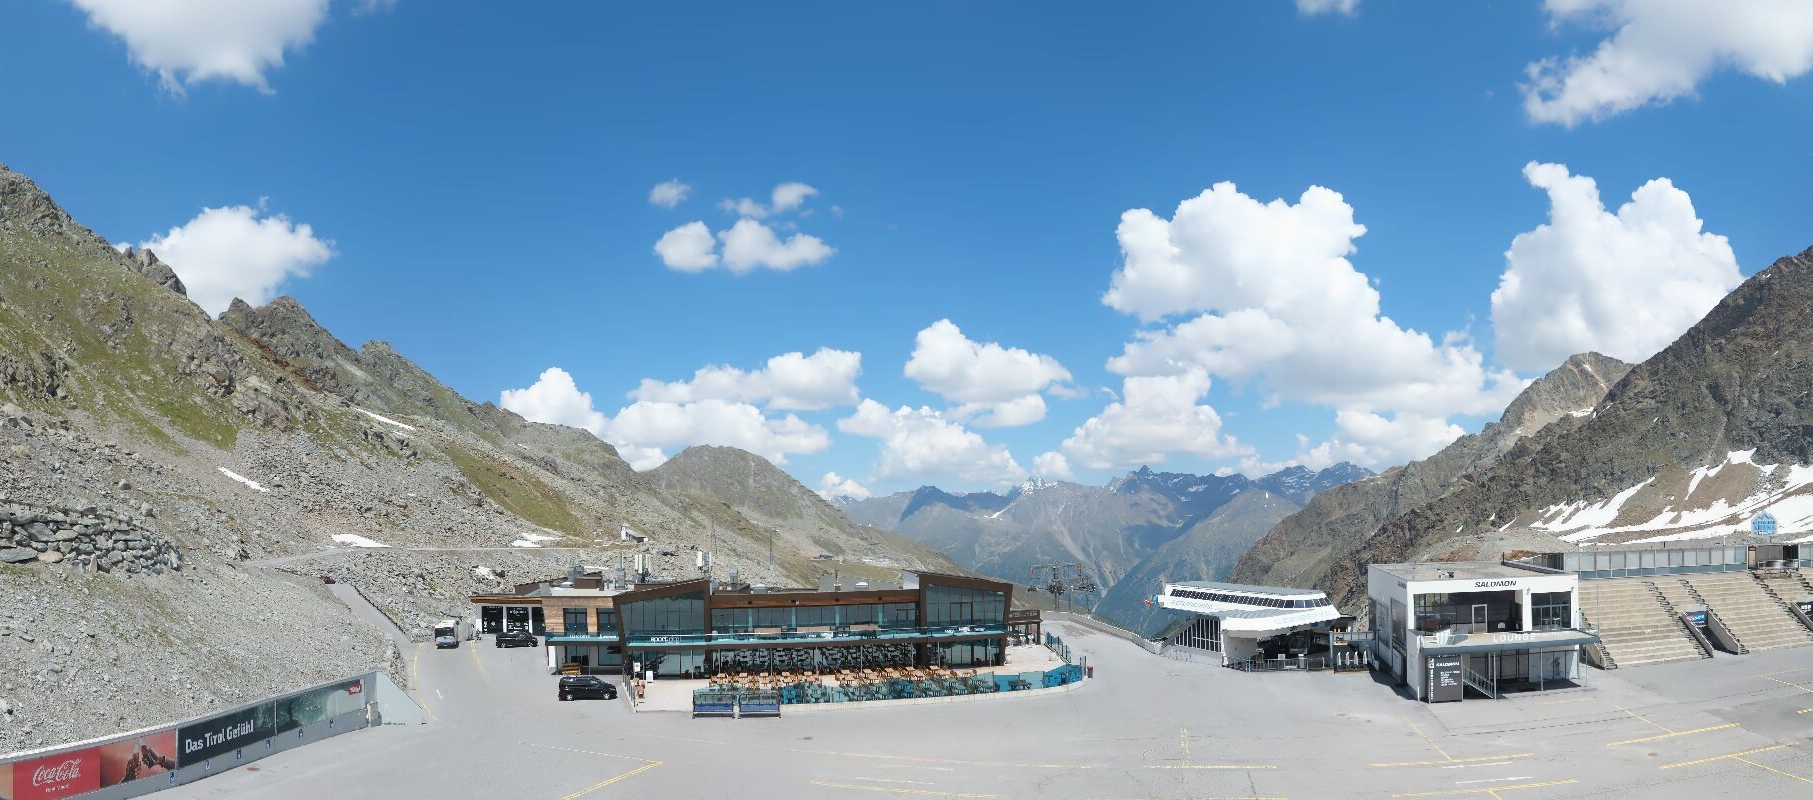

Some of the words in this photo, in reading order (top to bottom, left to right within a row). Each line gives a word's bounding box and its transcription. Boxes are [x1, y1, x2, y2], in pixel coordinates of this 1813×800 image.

[1474, 580, 1517, 588] SALOMON
[1493, 633, 1536, 643] LOUNGE
[185, 738, 204, 754] Das
[204, 728, 225, 748] Tirol
[226, 719, 254, 741] Gefühl
[32, 758, 82, 786] Coca-Cola
